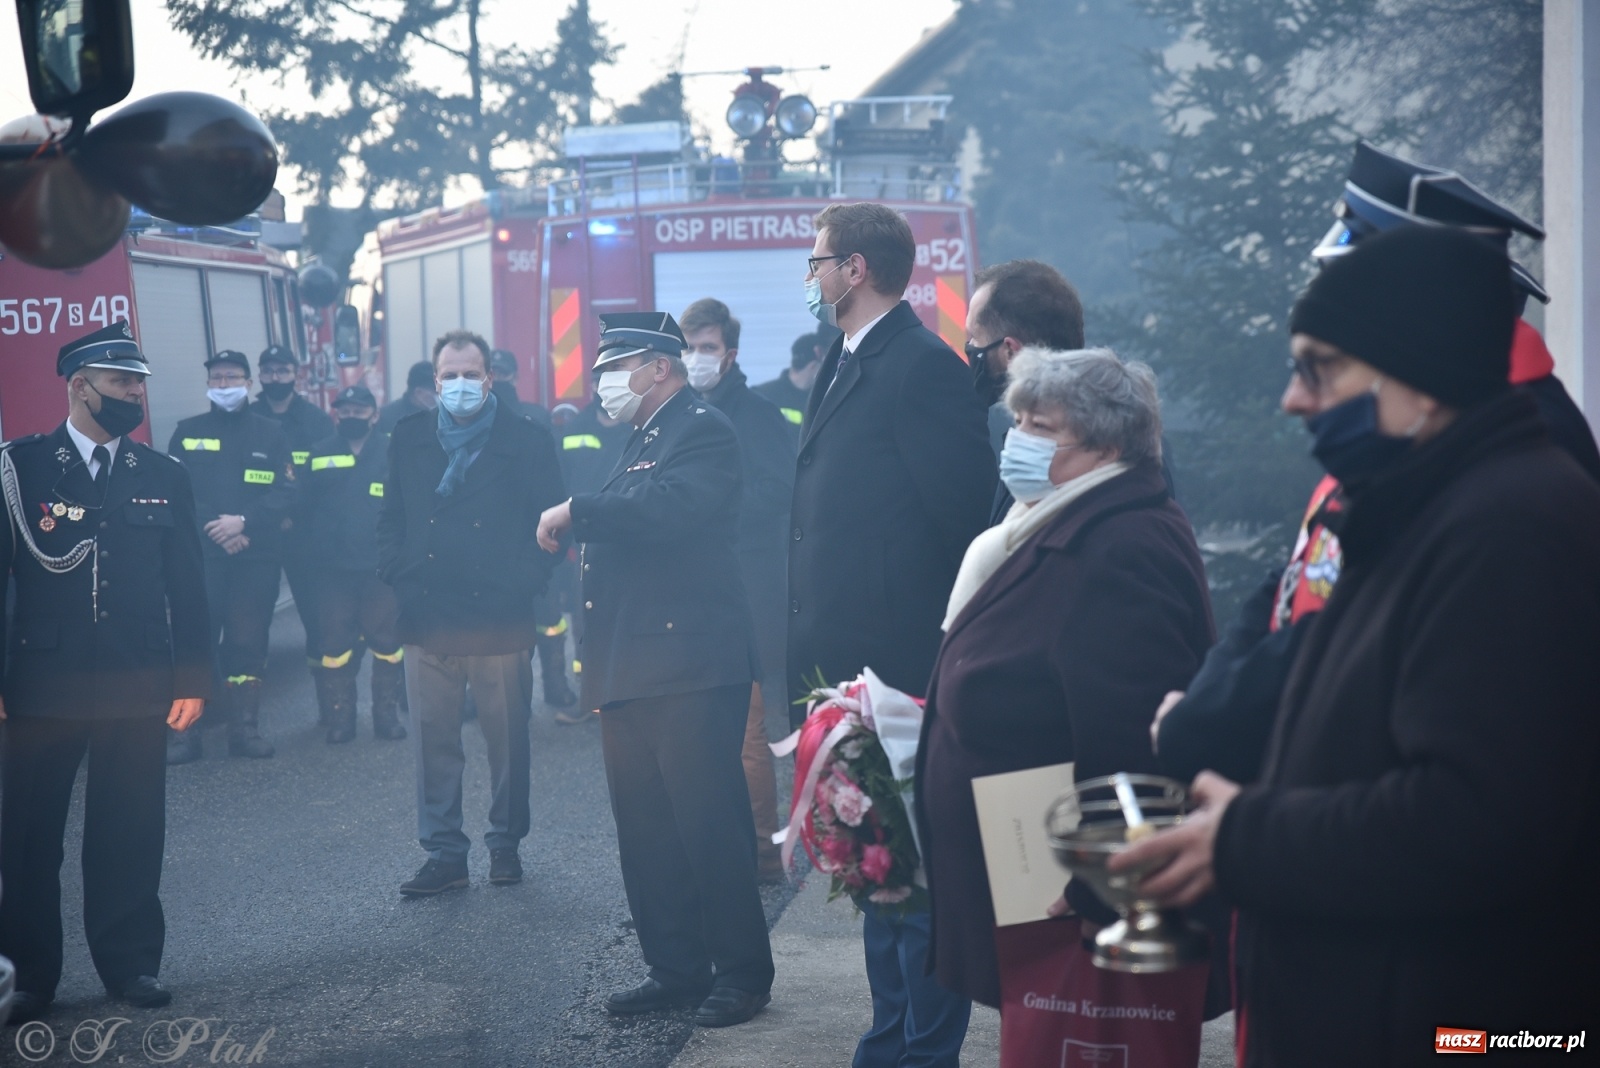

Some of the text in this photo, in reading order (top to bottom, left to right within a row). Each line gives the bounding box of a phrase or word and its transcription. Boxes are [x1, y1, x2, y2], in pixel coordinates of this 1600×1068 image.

[655, 214, 819, 243] OSP PIETRAS
[930, 238, 966, 272] 52
[905, 283, 937, 306] 98
[0, 295, 129, 335] 567 S 48
[1023, 991, 1177, 1021] Gmina Krzanowice
